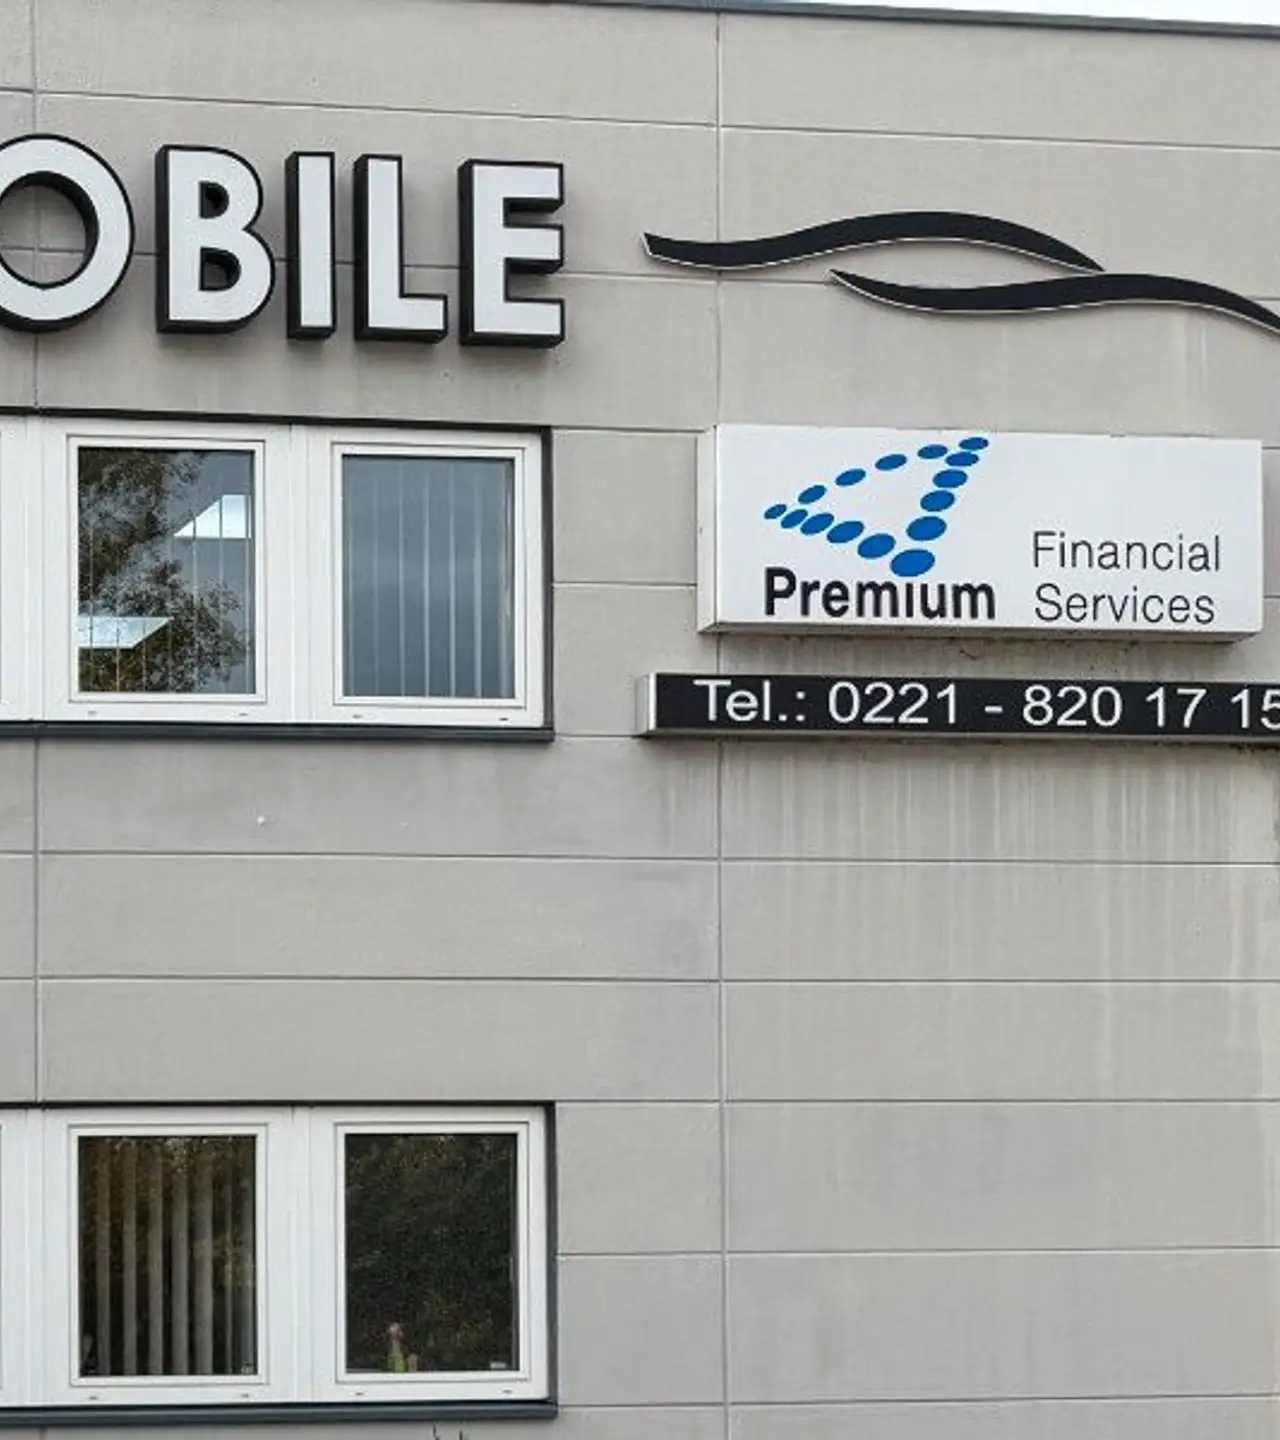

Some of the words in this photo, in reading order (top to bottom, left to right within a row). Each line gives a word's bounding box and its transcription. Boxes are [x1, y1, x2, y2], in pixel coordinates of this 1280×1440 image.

[1033, 530, 1222, 573] Financial
[763, 566, 996, 620] Premium
[1034, 584, 1216, 625] Services
[693, 678, 806, 723] Tel.:
[827, 681, 959, 726] 0221
[1022, 684, 1123, 728] 820
[1145, 686, 1208, 729] 17
